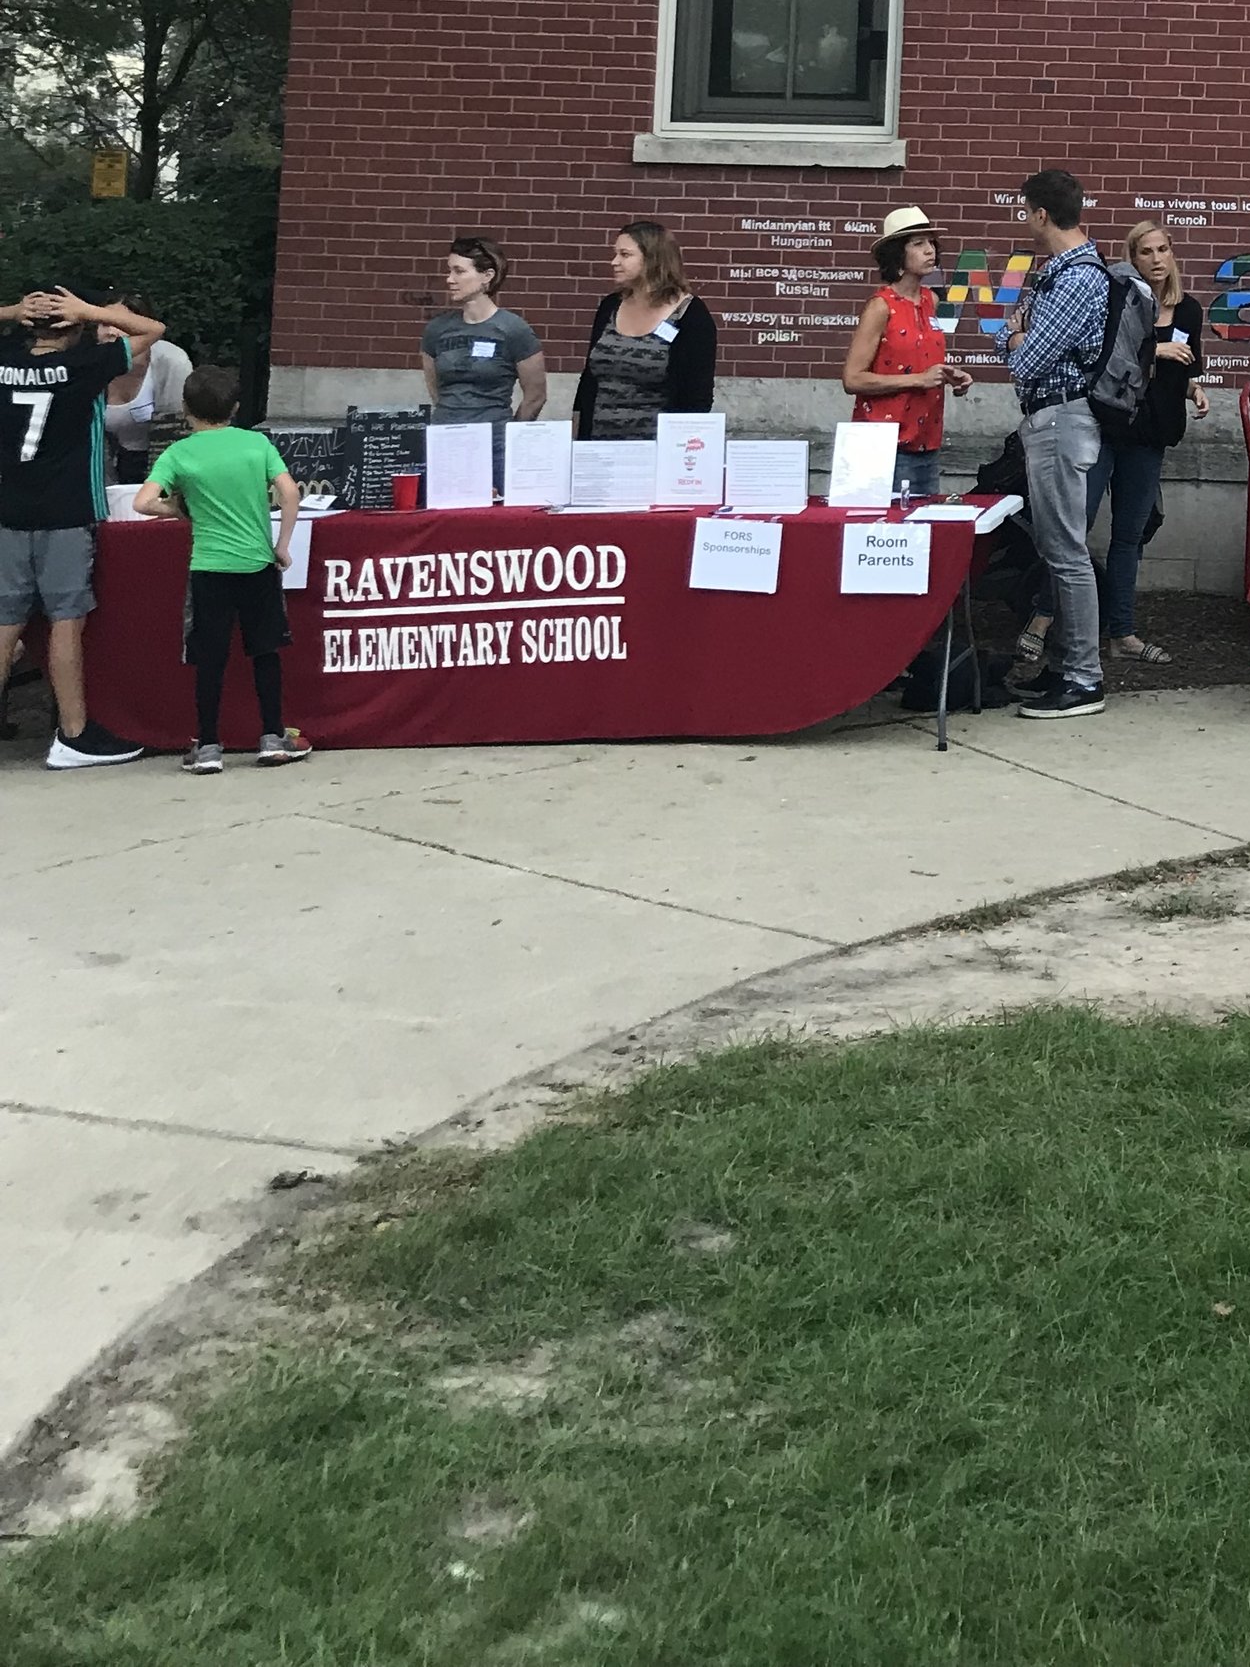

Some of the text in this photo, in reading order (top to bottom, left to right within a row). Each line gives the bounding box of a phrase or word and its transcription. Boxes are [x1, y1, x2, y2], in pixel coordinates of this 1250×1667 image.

[994, 194, 1014, 204] Wir
[1134, 197, 1165, 208] Nous
[1168, 199, 1206, 209] vivons
[1211, 200, 1237, 210] tous
[1166, 214, 1207, 226] French
[771, 235, 832, 248] Hungarian
[775, 282, 830, 297] Russian
[721, 312, 778, 326] wszyscy
[780, 314, 794, 326] tu
[757, 330, 801, 344] polish
[12, 391, 54, 462] 7
[724, 531, 753, 541] FORS
[866, 535, 908, 548] Room
[702, 542, 772, 556] Sponsorships
[858, 553, 914, 566] Parents
[323, 544, 627, 603] RAVENSWOOD
[323, 615, 627, 673] ELEMENTARY SCHOOL
